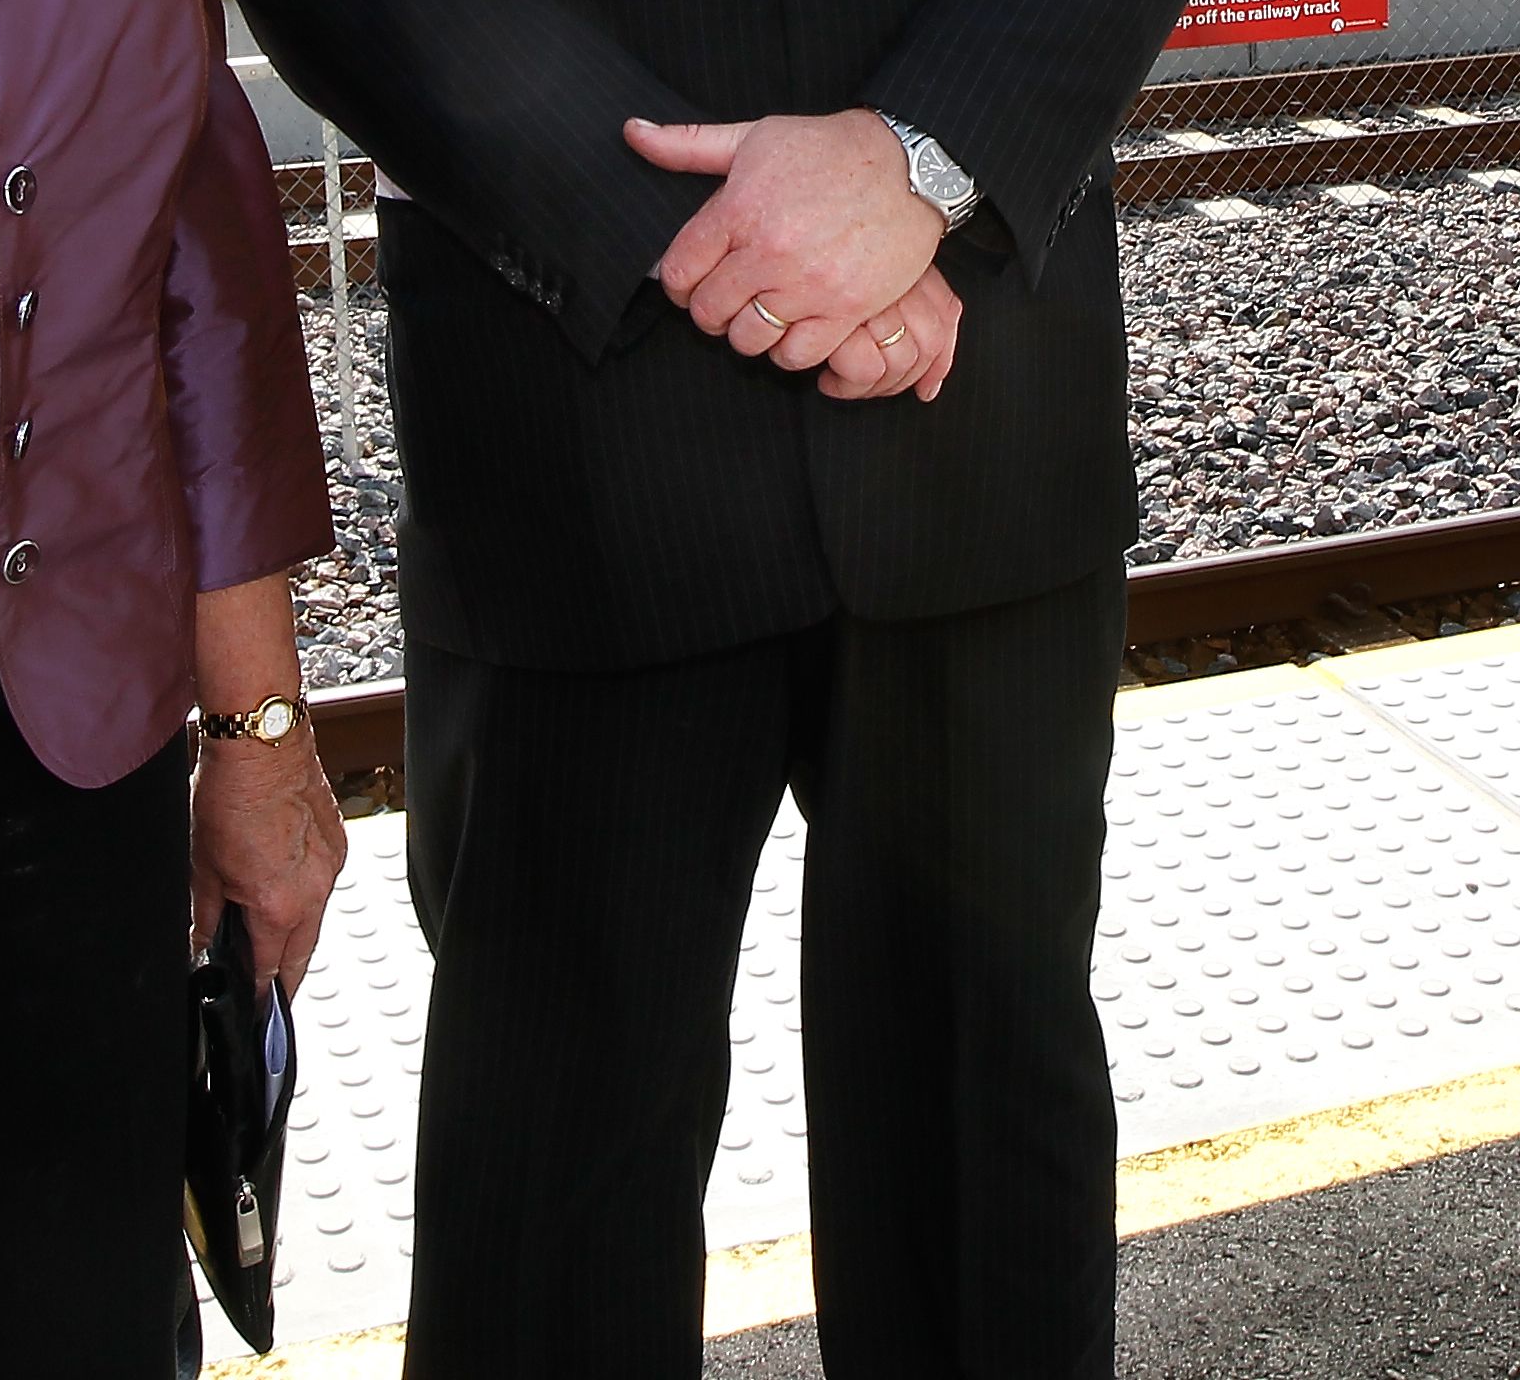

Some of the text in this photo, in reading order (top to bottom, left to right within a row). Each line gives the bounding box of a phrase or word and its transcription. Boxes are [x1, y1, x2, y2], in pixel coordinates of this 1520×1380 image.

[1196, 9, 1218, 25] off
[1220, 8, 1245, 23] the
[1248, 4, 1301, 21] railway
